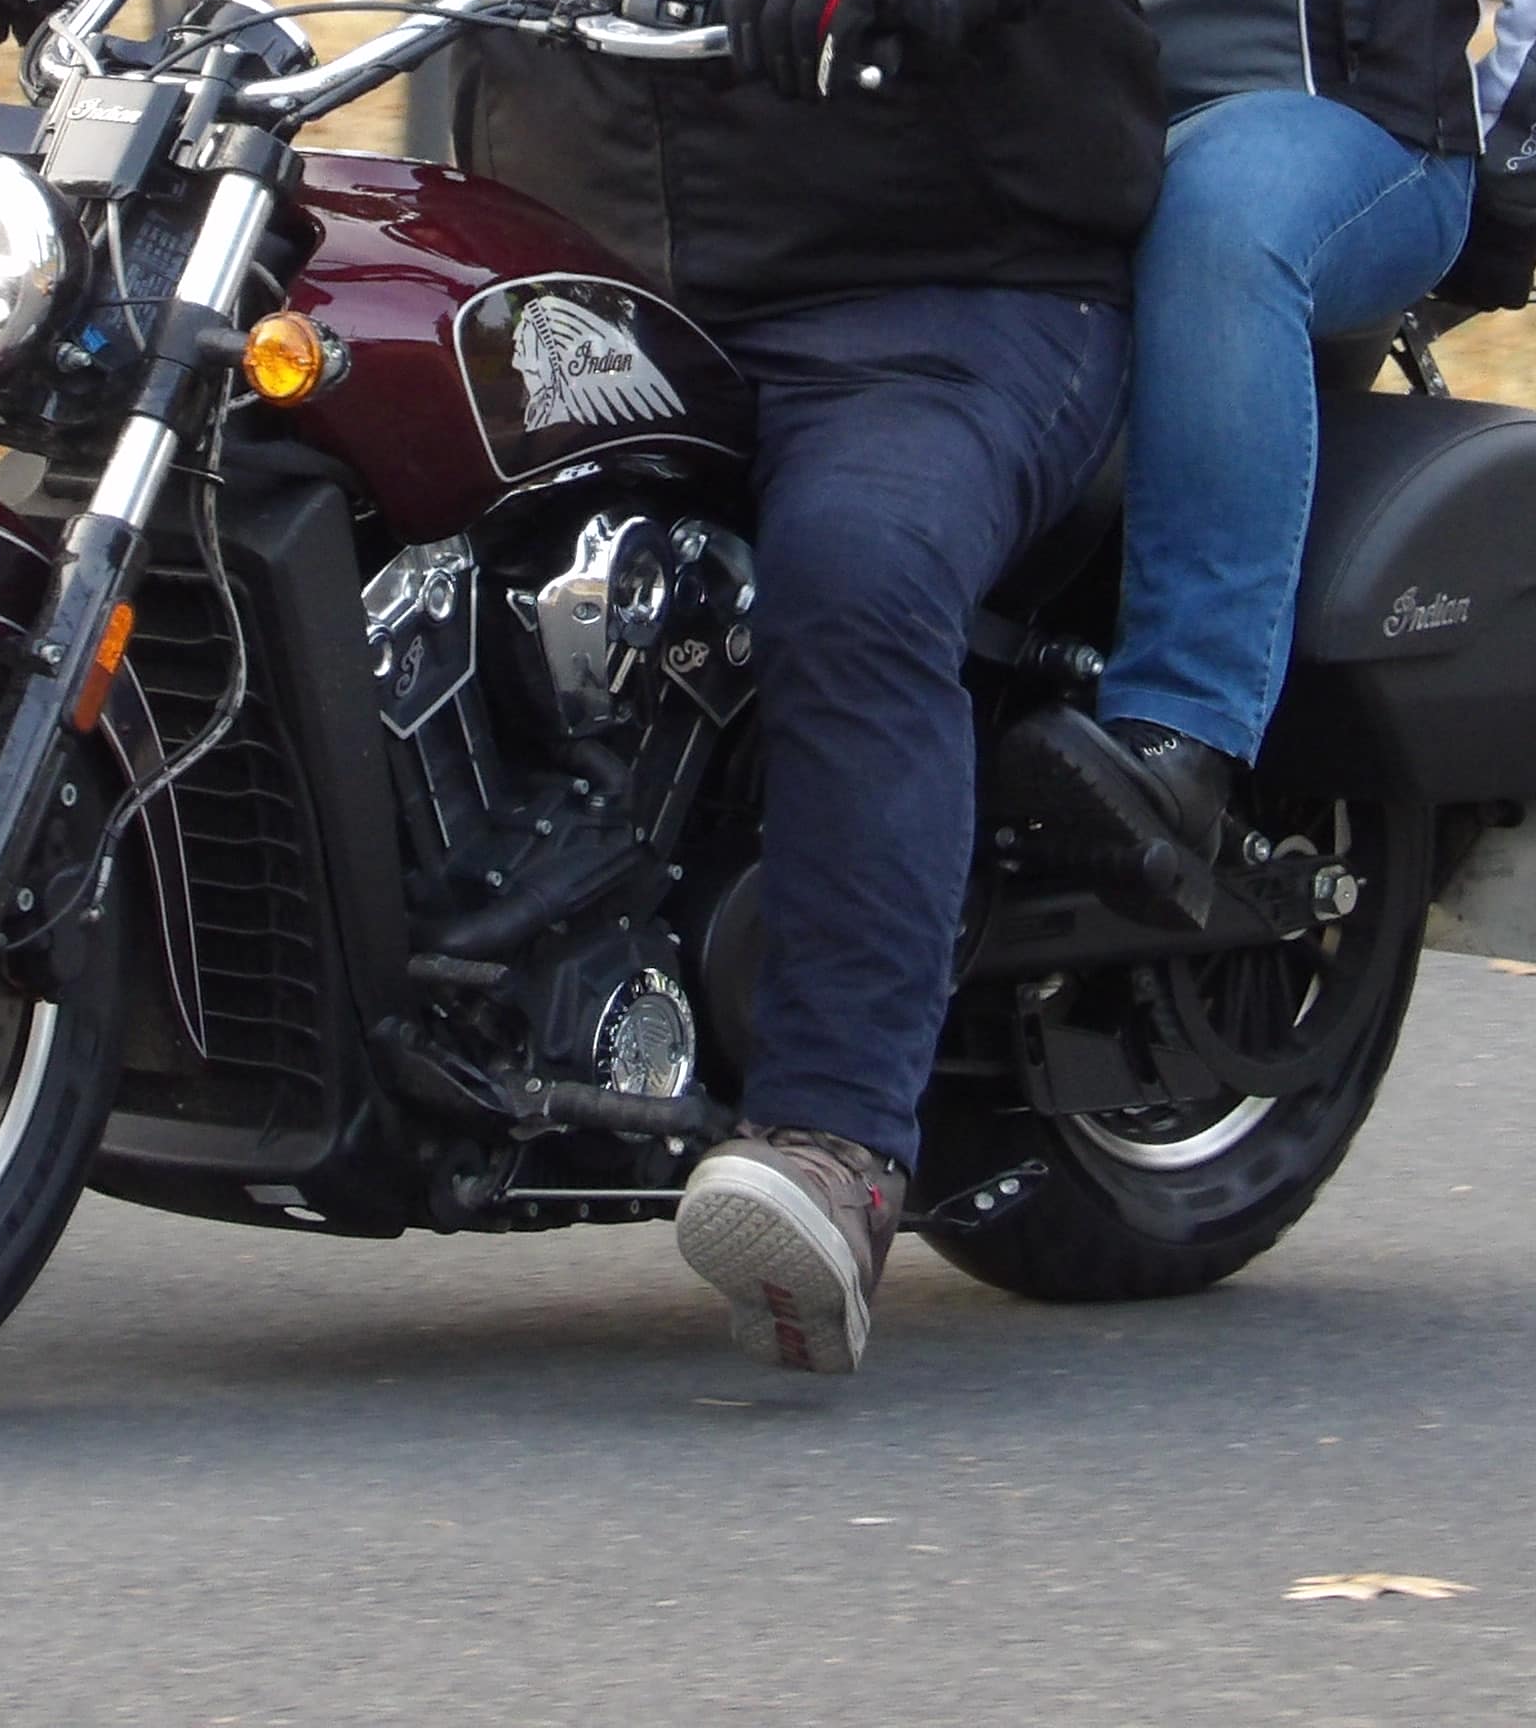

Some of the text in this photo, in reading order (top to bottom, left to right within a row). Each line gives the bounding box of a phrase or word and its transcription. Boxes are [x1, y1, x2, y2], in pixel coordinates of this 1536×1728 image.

[66, 97, 144, 125] Indian
[567, 339, 634, 377] Indian
[1382, 585, 1472, 639] Indian
